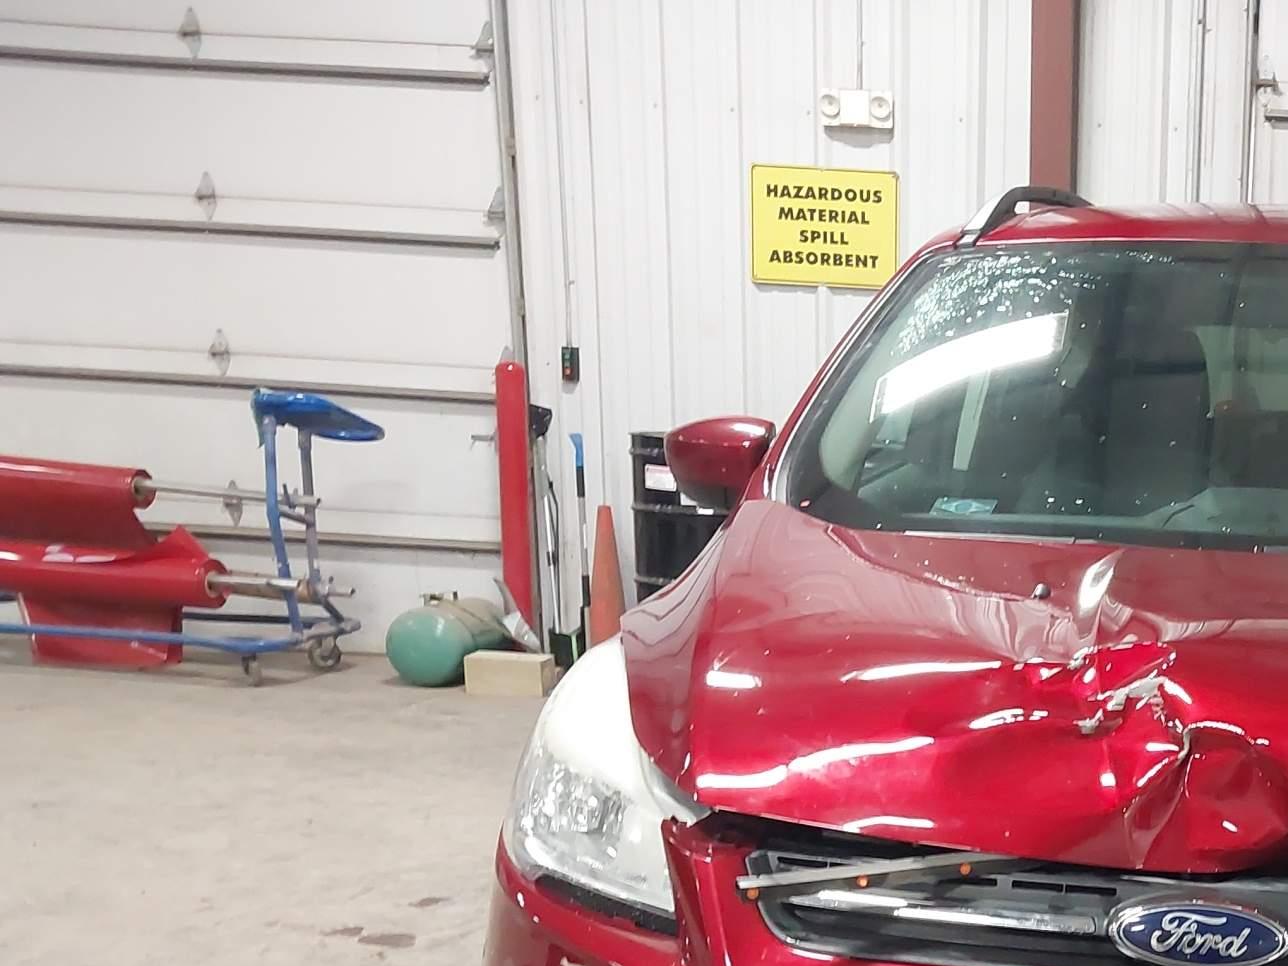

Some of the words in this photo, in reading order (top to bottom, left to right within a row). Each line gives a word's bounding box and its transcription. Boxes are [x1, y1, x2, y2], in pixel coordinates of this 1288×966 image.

[766, 184, 882, 204] HAZARDOUS
[778, 207, 870, 225] MATERIAL
[799, 230, 849, 245] SPILL
[769, 250, 879, 269] ABSORBENT
[1150, 911, 1251, 958] Ford
